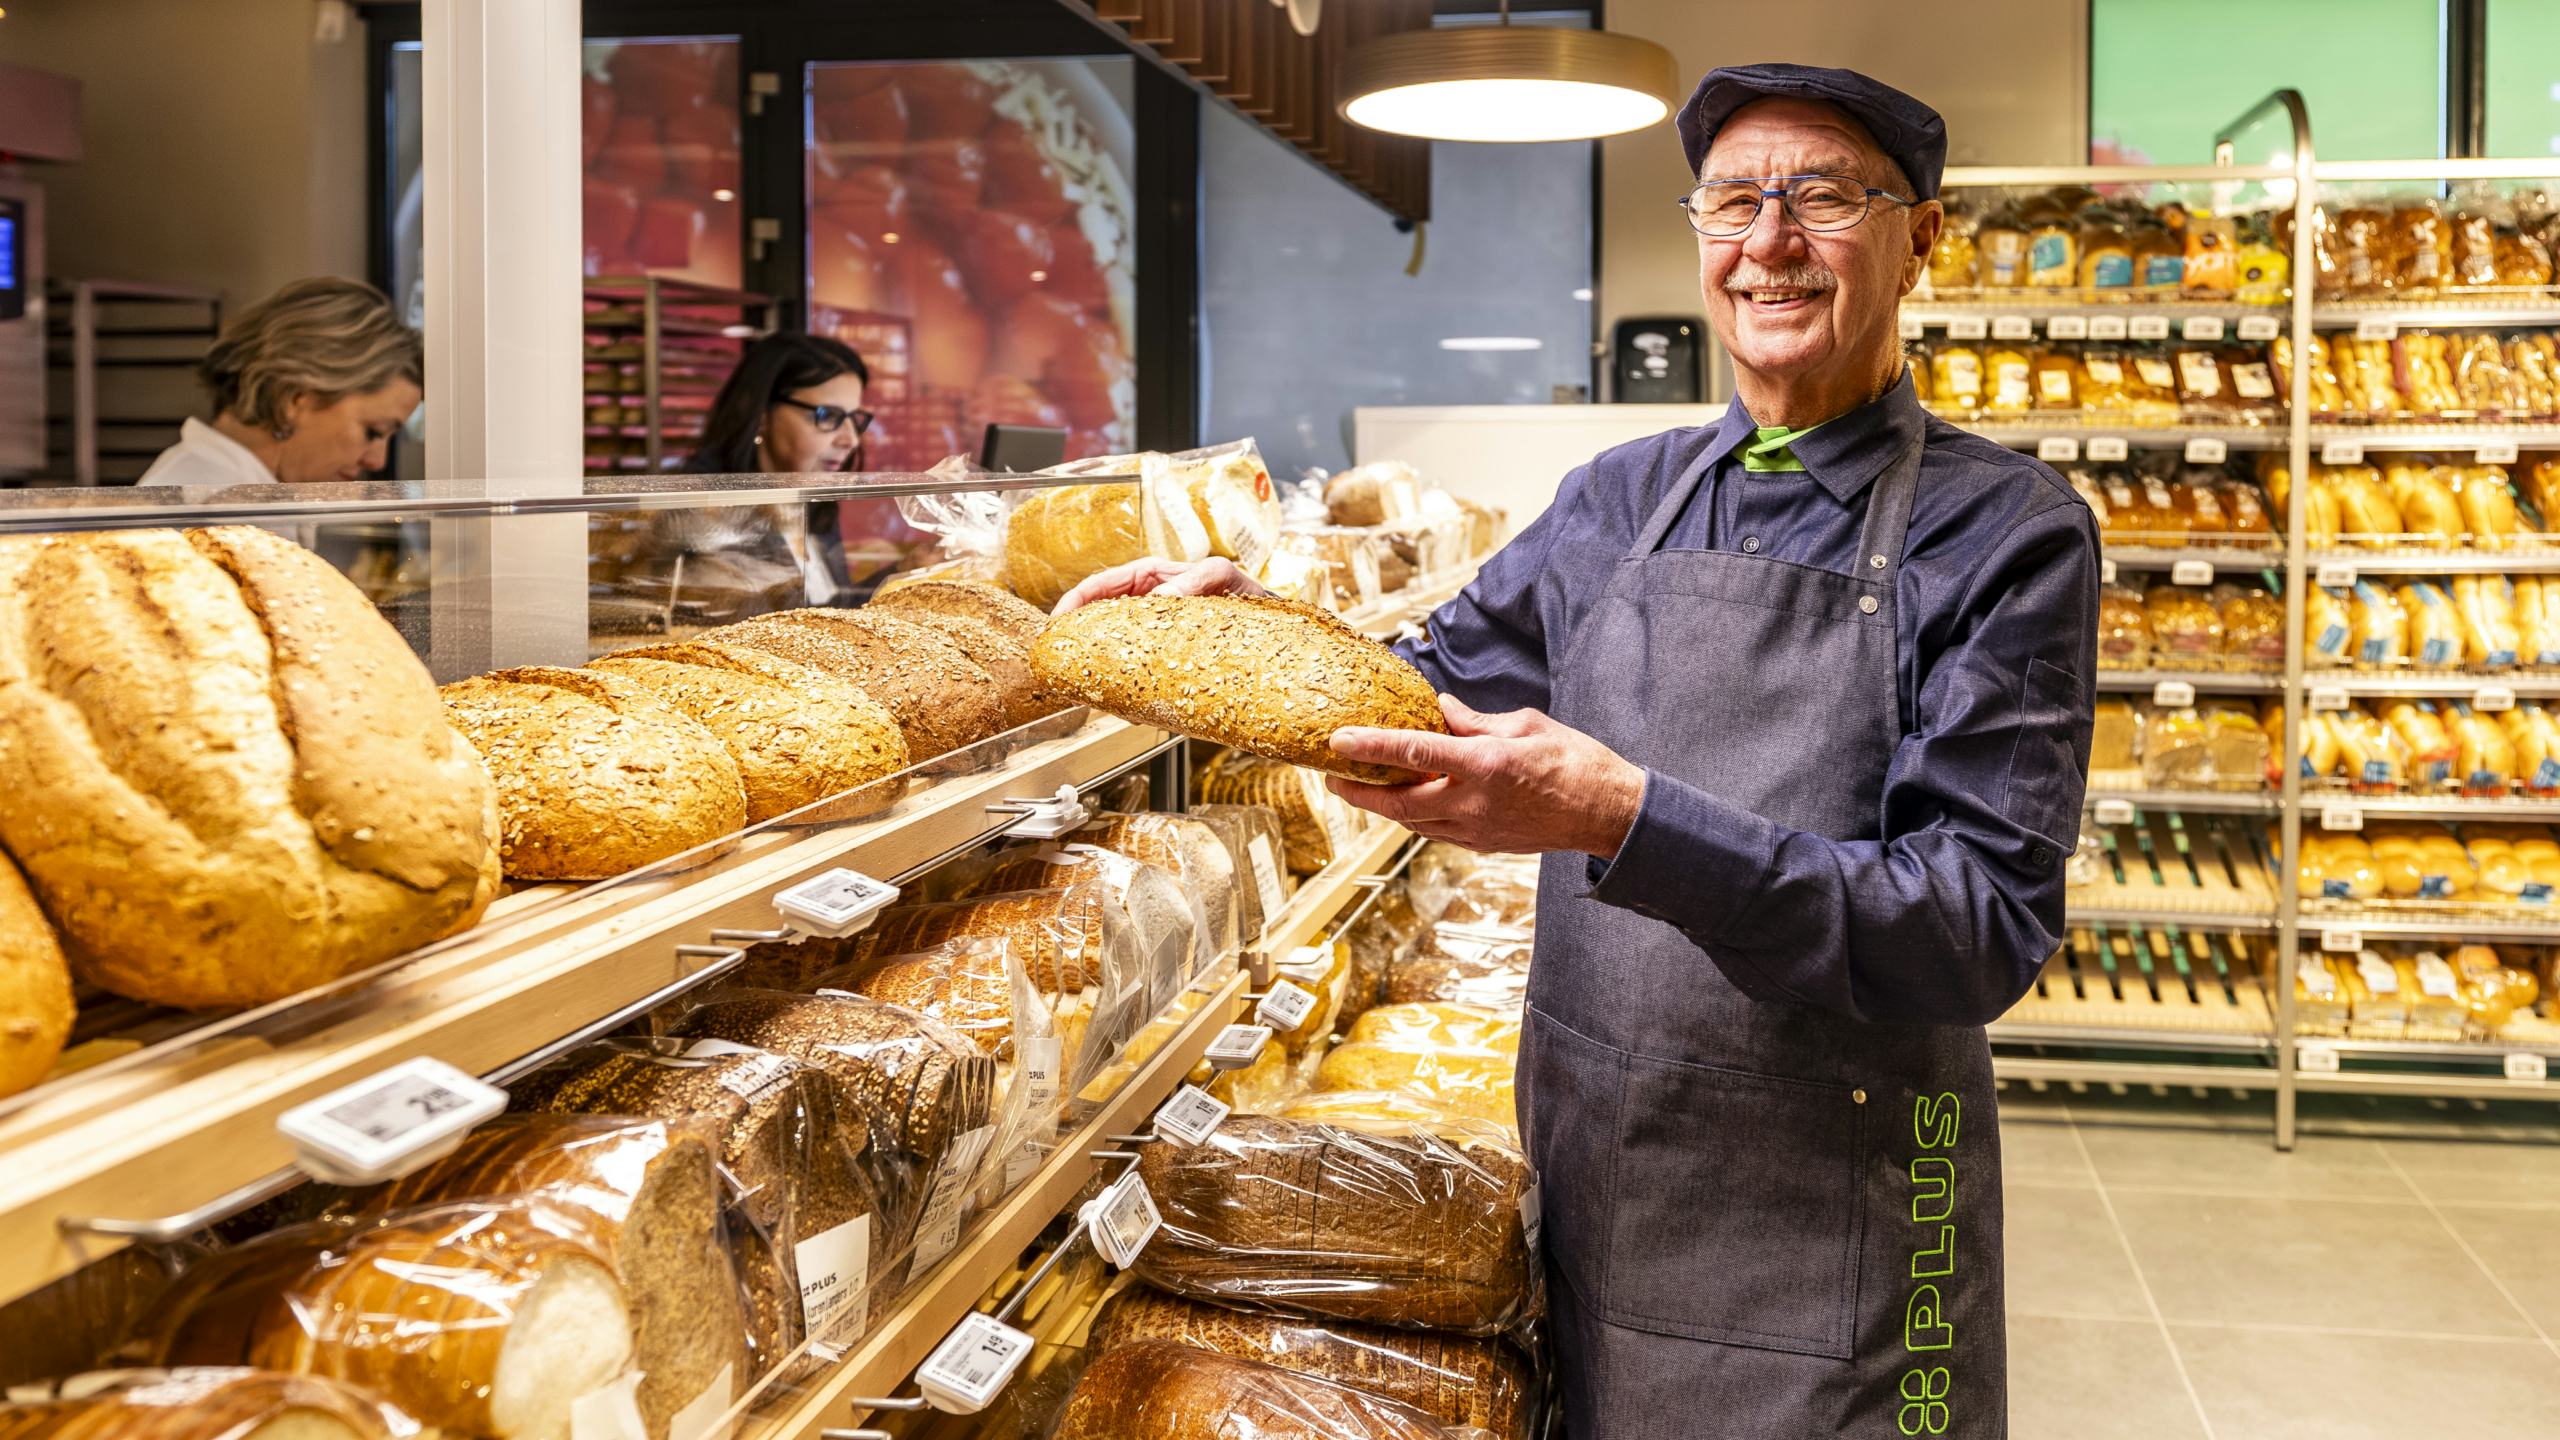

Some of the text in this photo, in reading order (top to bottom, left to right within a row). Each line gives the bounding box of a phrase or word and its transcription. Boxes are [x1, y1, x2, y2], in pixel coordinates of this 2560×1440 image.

[1905, 1092, 1960, 1351] PLUS
[811, 1272, 838, 1295] PLUS
[981, 1334, 1008, 1357] 1.49
